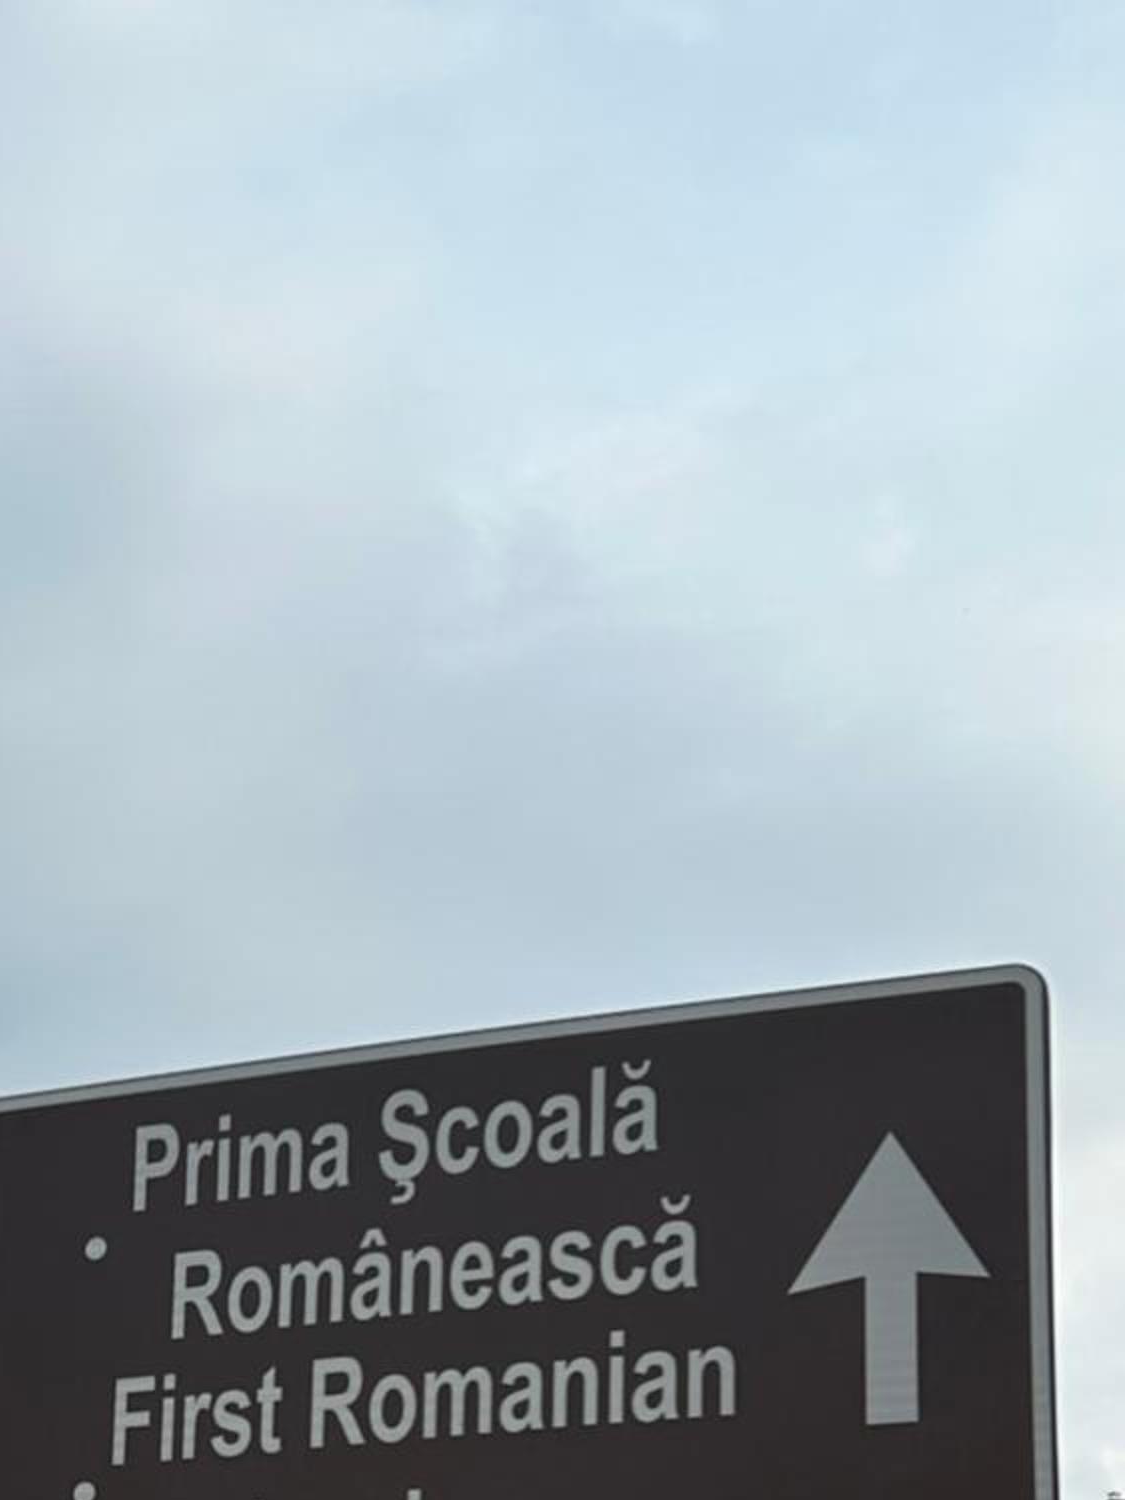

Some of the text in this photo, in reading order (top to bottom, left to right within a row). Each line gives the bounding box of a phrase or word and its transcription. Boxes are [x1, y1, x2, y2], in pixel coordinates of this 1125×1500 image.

[133, 1060, 658, 1212] Prima Şcoală
[172, 1195, 697, 1339] Românească
[113, 1331, 735, 1465] First Romanian
